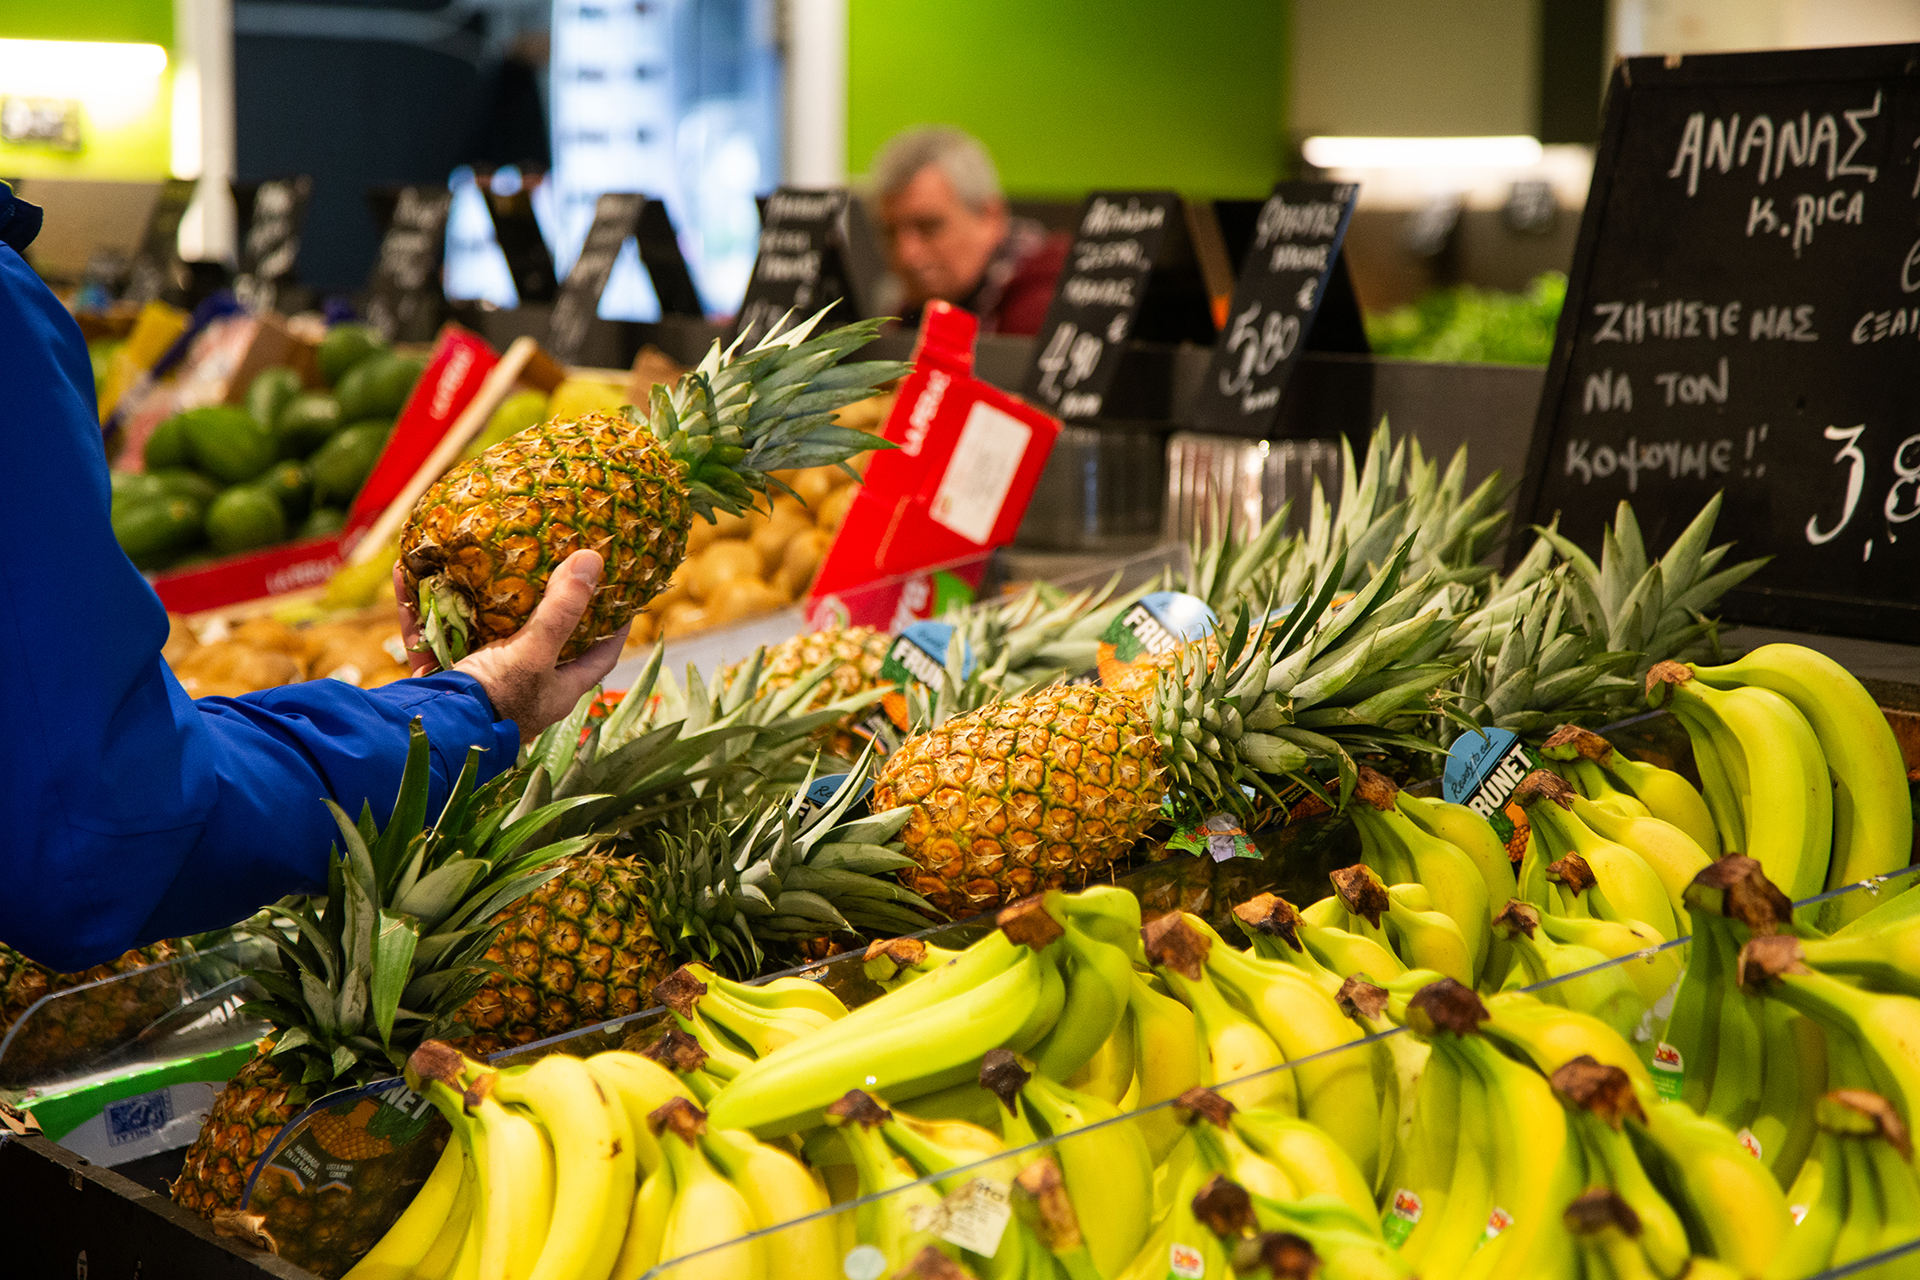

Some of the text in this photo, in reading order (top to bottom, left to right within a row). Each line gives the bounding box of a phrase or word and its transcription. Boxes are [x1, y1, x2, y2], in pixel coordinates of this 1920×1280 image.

[1667, 90, 1882, 197] ΑΝΑΝΑΣ
[1593, 299, 1742, 344] ΖΗΤΗΣΤΕ
[1852, 307, 1920, 345] ΕΞΑΙ
[1583, 356, 1729, 415] ΝΑ ΤΟΝ
[1451, 761, 1475, 799] Ready
[1468, 743, 1533, 821] RUNET
[297, 1159, 317, 1181] PLANTA
